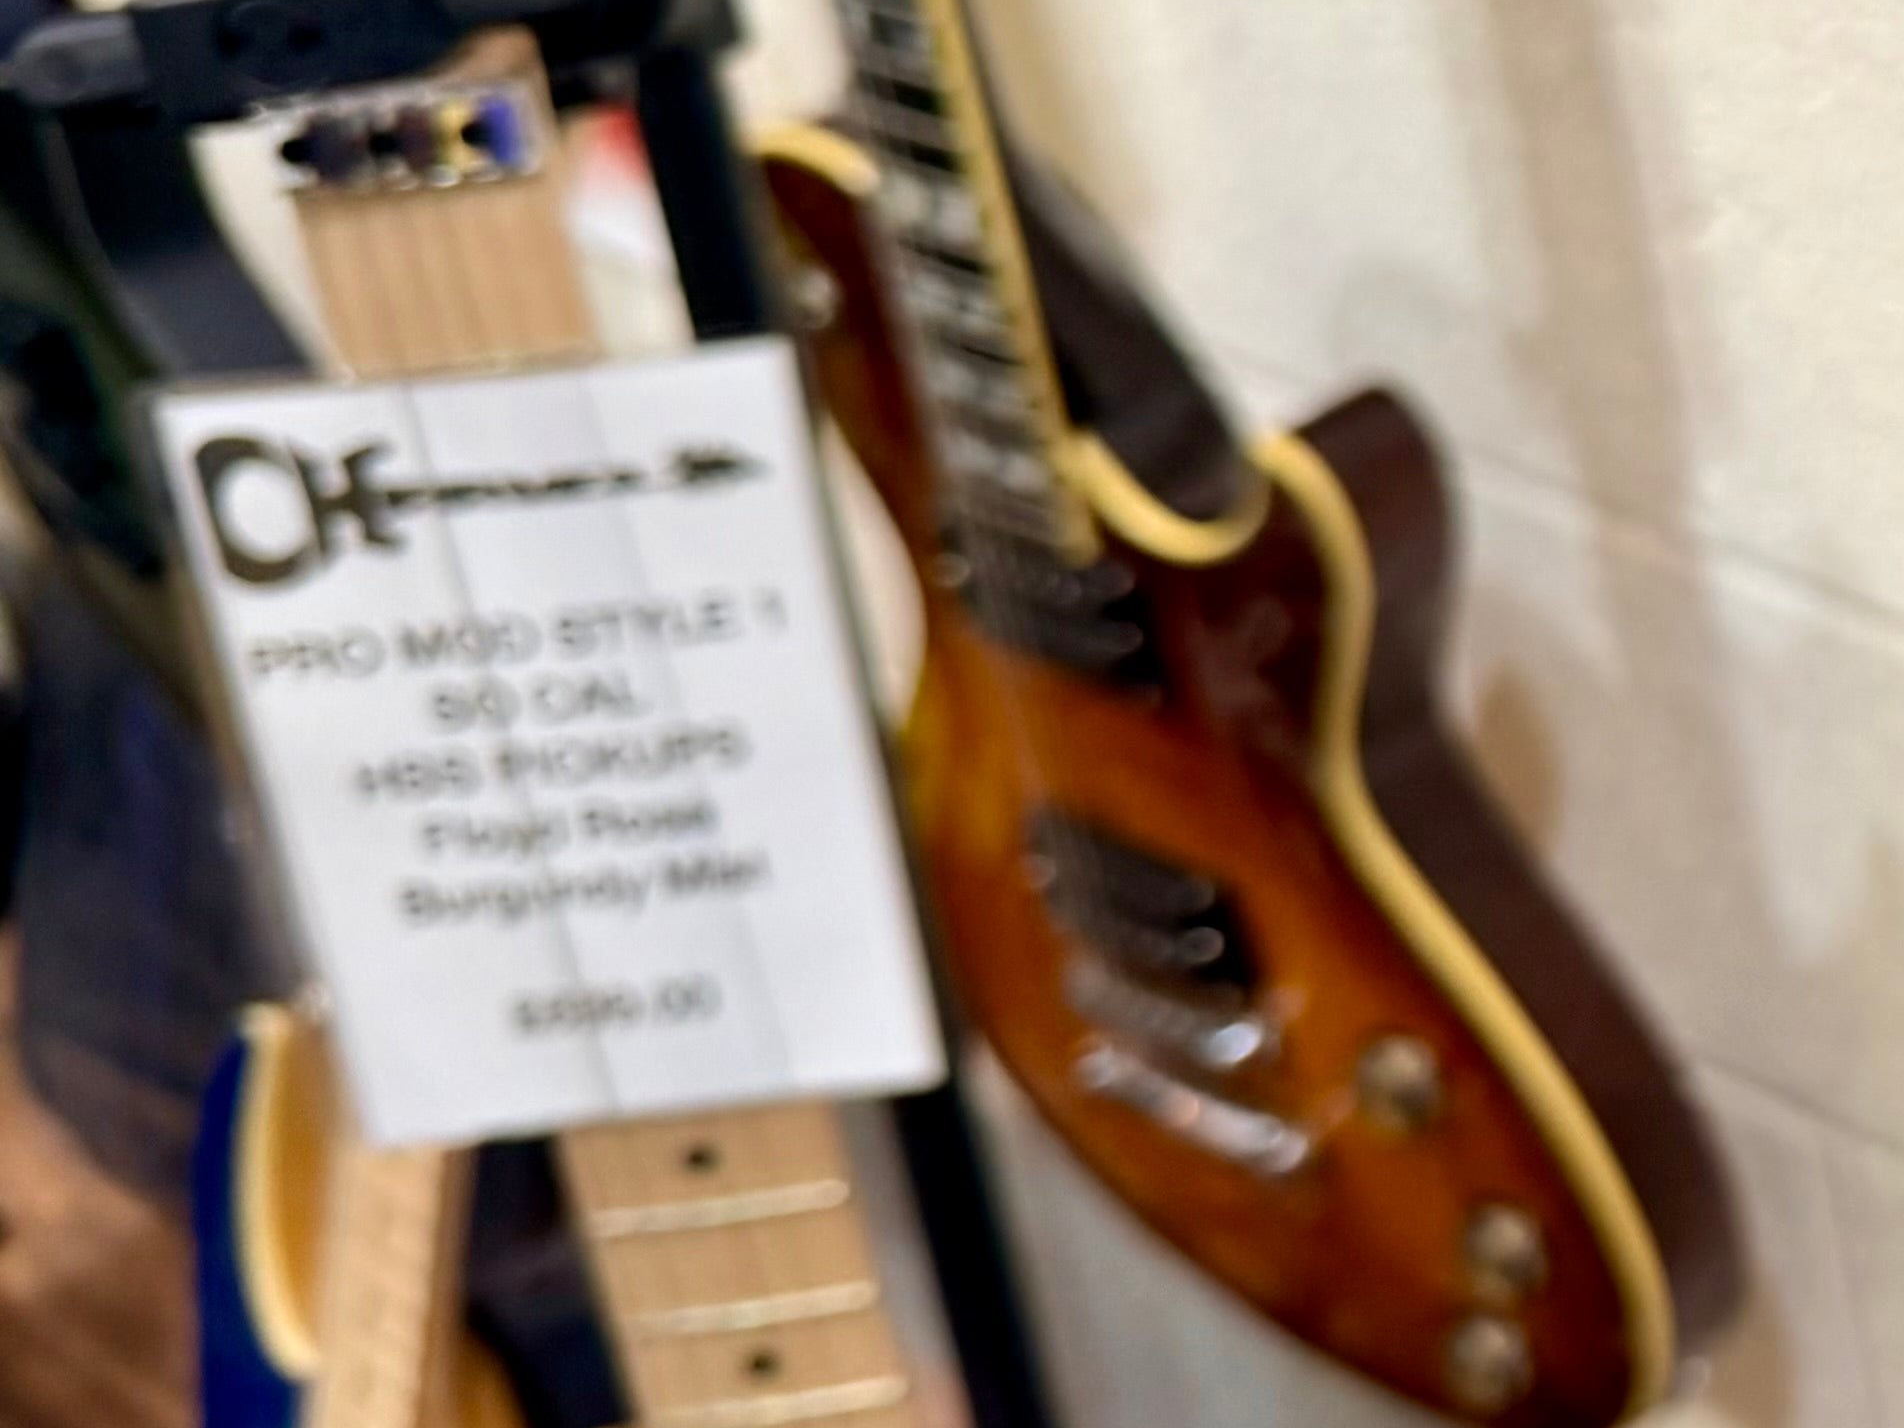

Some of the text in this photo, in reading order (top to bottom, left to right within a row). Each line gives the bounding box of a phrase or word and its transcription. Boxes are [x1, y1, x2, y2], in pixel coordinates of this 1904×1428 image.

[246, 623, 386, 677] PRO
[400, 611, 542, 667] MOD
[555, 588, 741, 658] STYLE
[492, 718, 752, 785] PICKUPS
